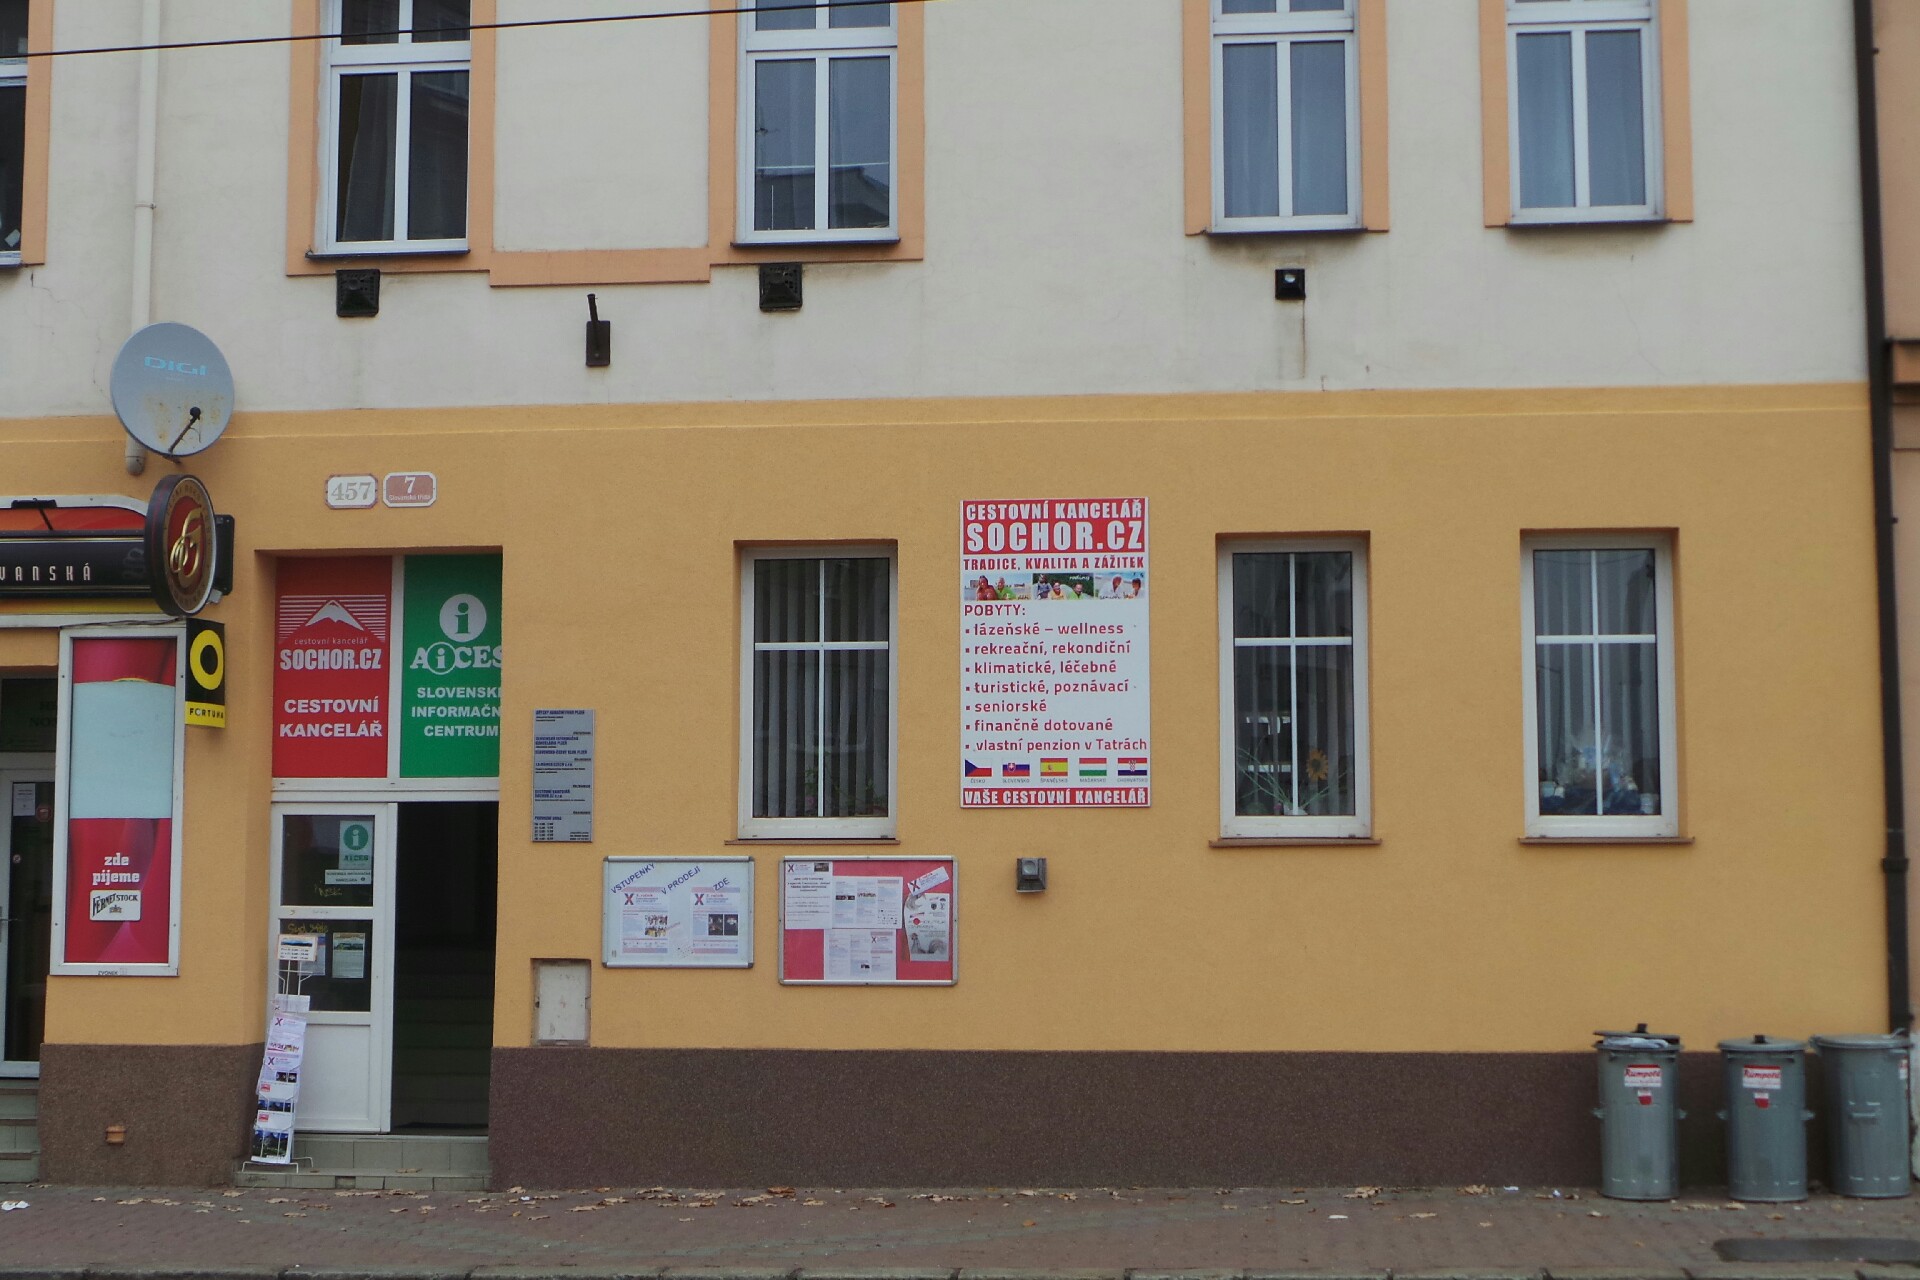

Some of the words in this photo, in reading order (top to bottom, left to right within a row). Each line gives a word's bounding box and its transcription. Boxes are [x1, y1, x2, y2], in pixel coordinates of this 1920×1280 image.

[143, 356, 208, 376] DIGI
[331, 481, 372, 501] 457
[404, 476, 416, 494] 7
[966, 500, 1048, 520] CESTOVNÍ
[1055, 498, 1142, 519] KANCELÁŘ
[967, 520, 1142, 552] SOCHOR.CZ
[963, 557, 1021, 571] TRADICE,
[1025, 557, 1078, 570] KVALITA
[1082, 557, 1090, 569] A
[1094, 554, 1144, 569] ZÁŽITEK
[964, 604, 1026, 616] POBYTY:
[974, 622, 1040, 636] lázeňské
[1058, 622, 1124, 635] wellness
[294, 637, 330, 645] cestovní
[332, 637, 368, 645] kancelář
[974, 642, 1048, 655] rekreační,
[1052, 641, 1131, 654] rekondiční
[280, 648, 382, 670] SOCHOR.CZ
[974, 661, 1056, 675] klimatické,
[1060, 660, 1117, 673] léčebné
[417, 686, 501, 698] SLOVENSK
[974, 680, 1049, 694] turistické,
[1054, 679, 1129, 695] poznávací
[284, 695, 379, 713] CESTOVNÍ
[974, 699, 1047, 712] seniorské
[189, 707, 224, 719] FORTUNA
[279, 719, 383, 738] KANCELÁŘ
[423, 725, 499, 737] CENTRUM
[974, 718, 1039, 731] finančně
[1044, 718, 1113, 731] dotované
[976, 738, 1023, 751] vlastní
[1027, 738, 1080, 753] penzion
[1084, 740, 1092, 749] v
[1095, 738, 1147, 750] Tatrách
[964, 788, 999, 804] VAŠE
[1002, 788, 1070, 804] CESTOVNÍ
[1076, 787, 1146, 804] KANCELÁŘ
[104, 852, 129, 866] zde
[92, 869, 140, 885] pijeme
[610, 862, 655, 894] VSTUPENKY
[712, 877, 730, 892] ZDE
[116, 894, 138, 902] STOCK
